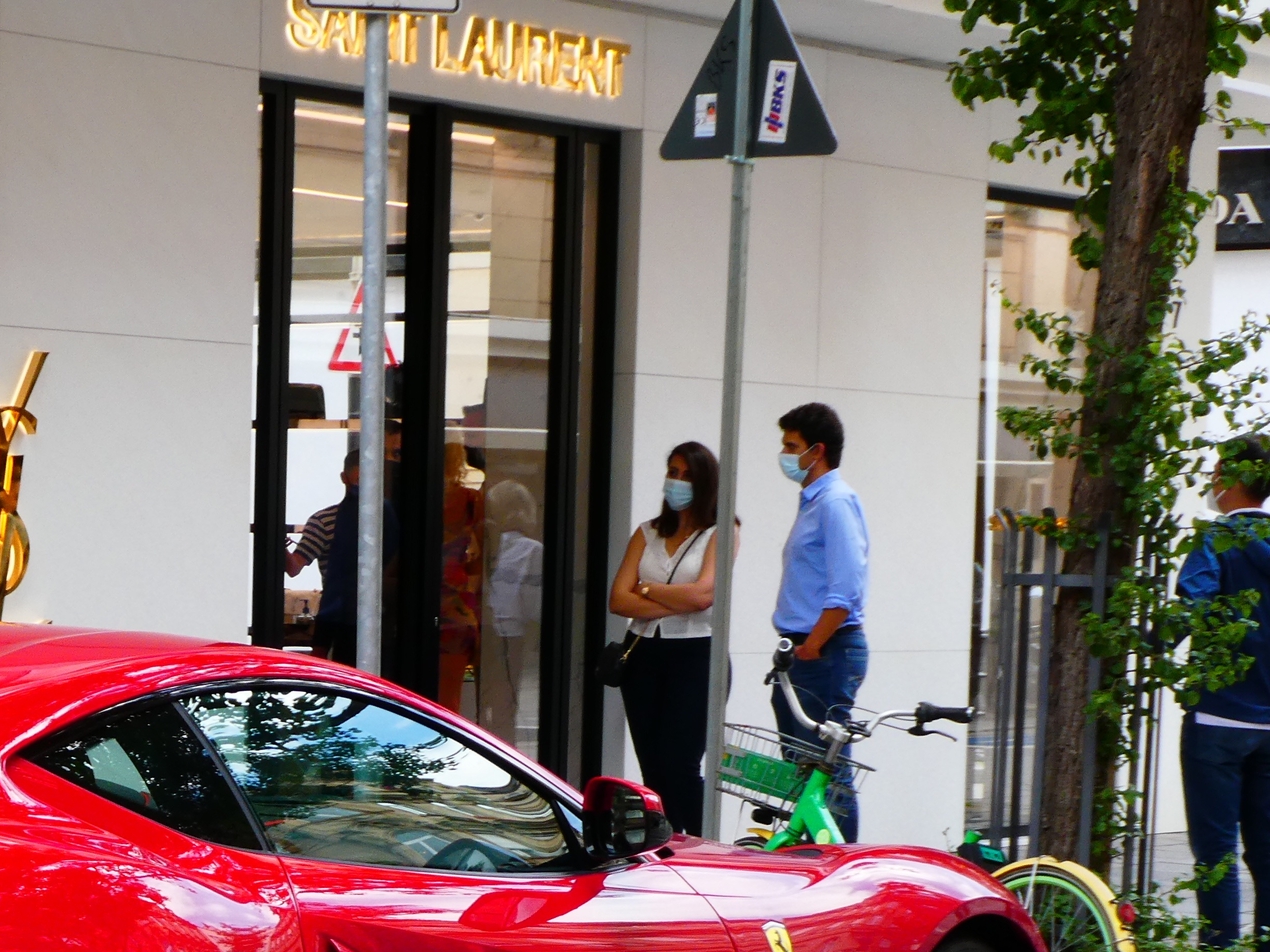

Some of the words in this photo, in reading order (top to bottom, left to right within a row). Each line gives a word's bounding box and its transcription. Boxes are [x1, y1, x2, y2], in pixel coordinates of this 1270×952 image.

[285, 0, 427, 65] SAIT
[431, 13, 631, 98] LAURENT
[770, 68, 787, 114] BKS
